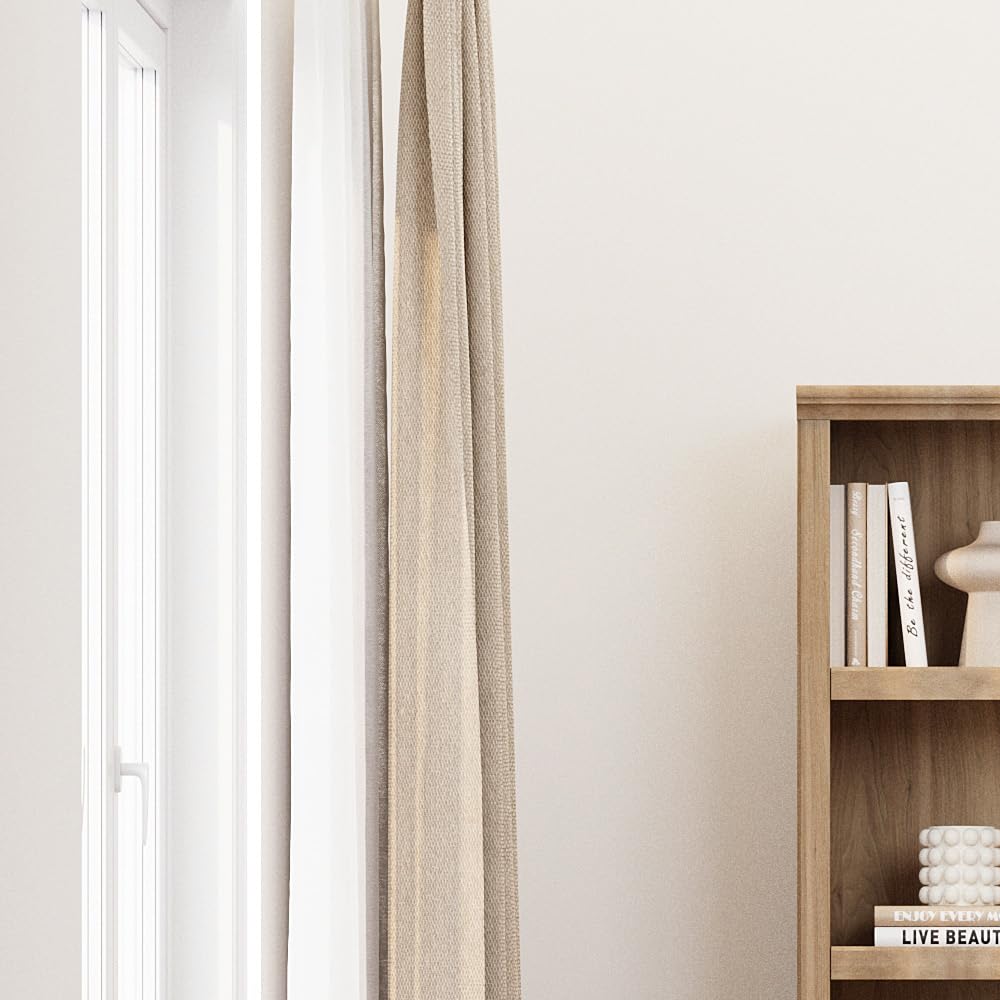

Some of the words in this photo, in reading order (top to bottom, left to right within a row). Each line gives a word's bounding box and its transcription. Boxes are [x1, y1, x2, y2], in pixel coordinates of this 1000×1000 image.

[896, 516, 917, 581] different
[906, 587, 914, 610] the
[907, 618, 919, 638] Be
[893, 910, 936, 922] ENJOY
[939, 910, 984, 922] EVERY
[902, 929, 939, 945] LIVE
